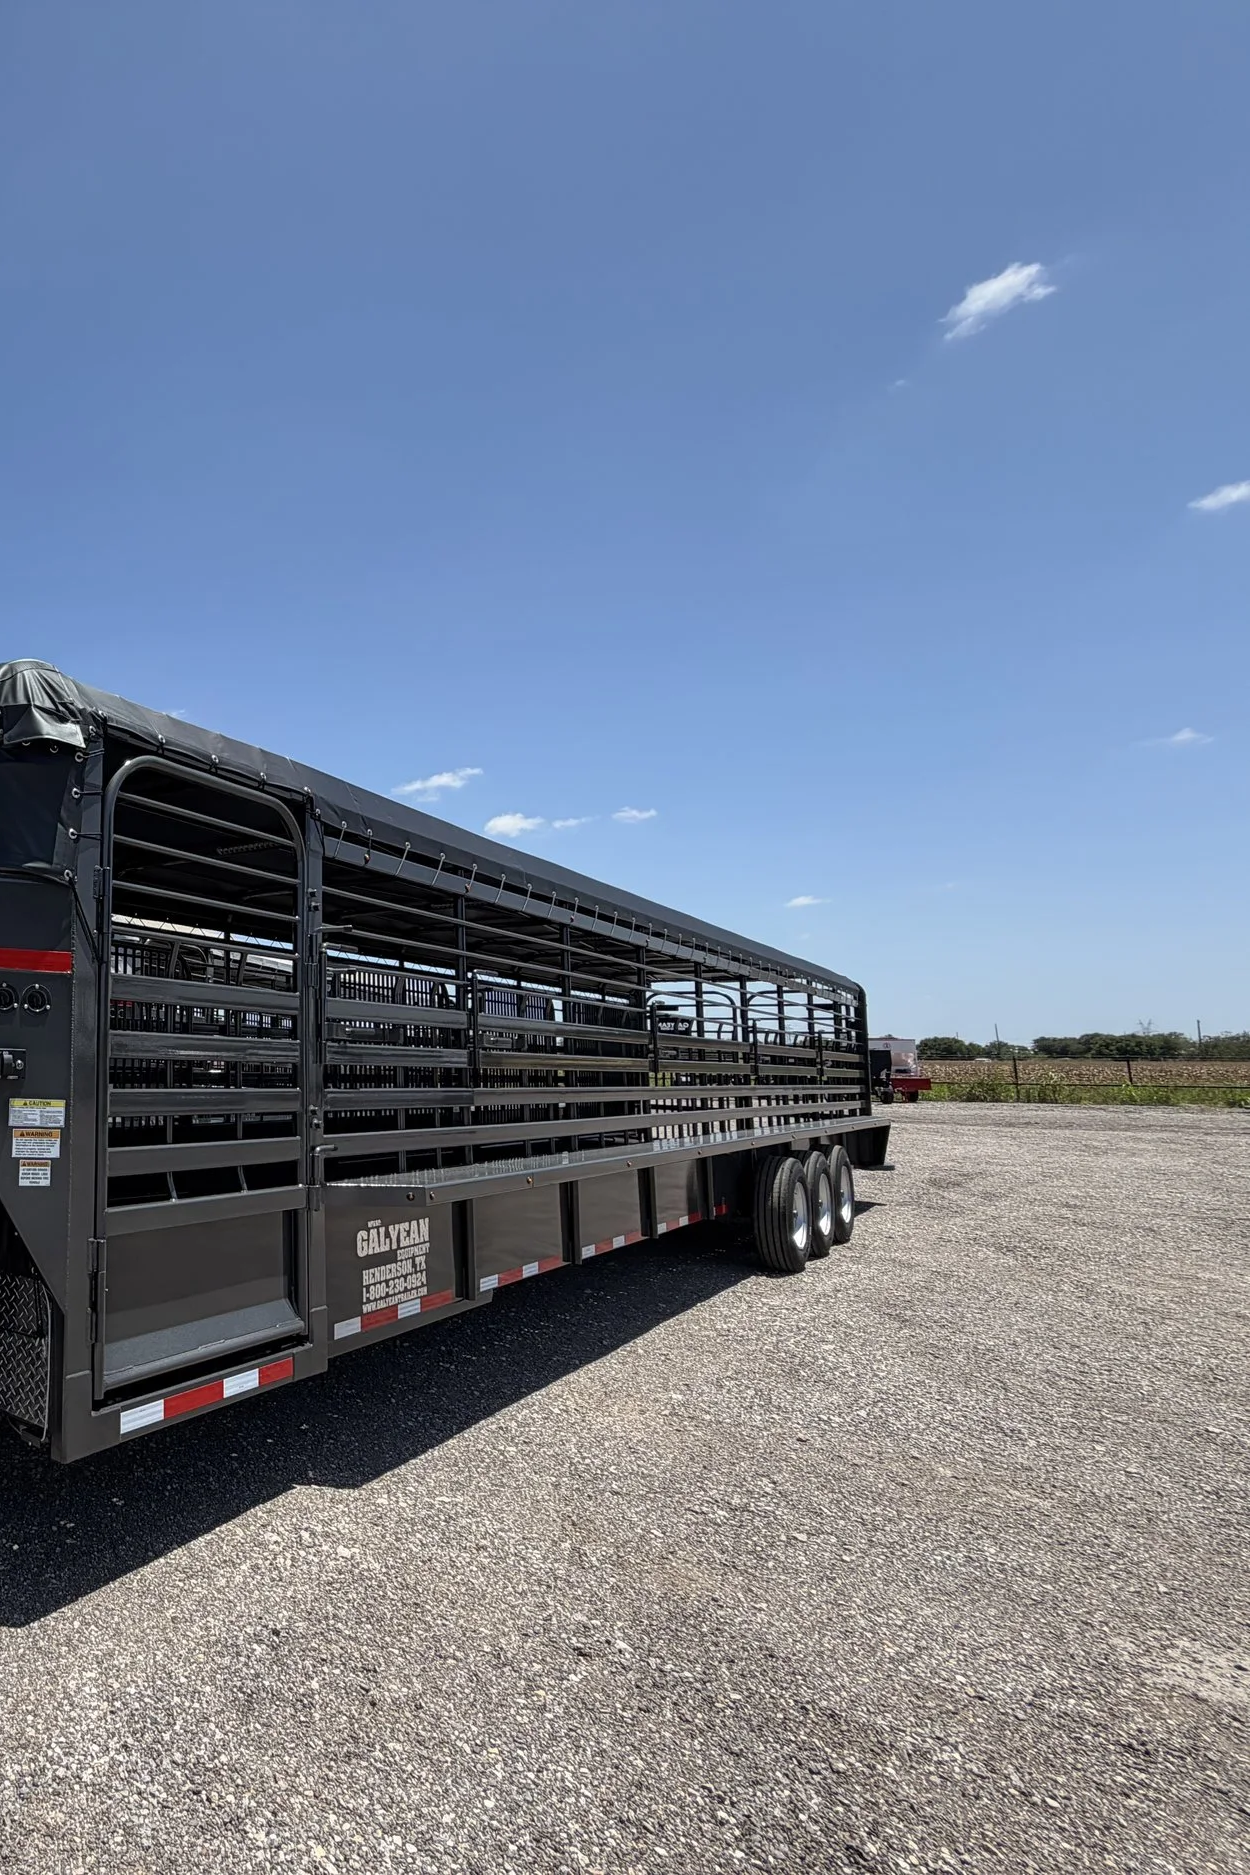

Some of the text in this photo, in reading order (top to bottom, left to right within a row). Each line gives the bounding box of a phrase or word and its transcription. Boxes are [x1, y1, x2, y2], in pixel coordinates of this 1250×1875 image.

[356, 1217, 430, 1258] GALYEAN
[397, 1242, 430, 1261] EQUIPMENT
[415, 1255, 426, 1271] TX
[362, 1270, 427, 1303] 1-800-230-0924
